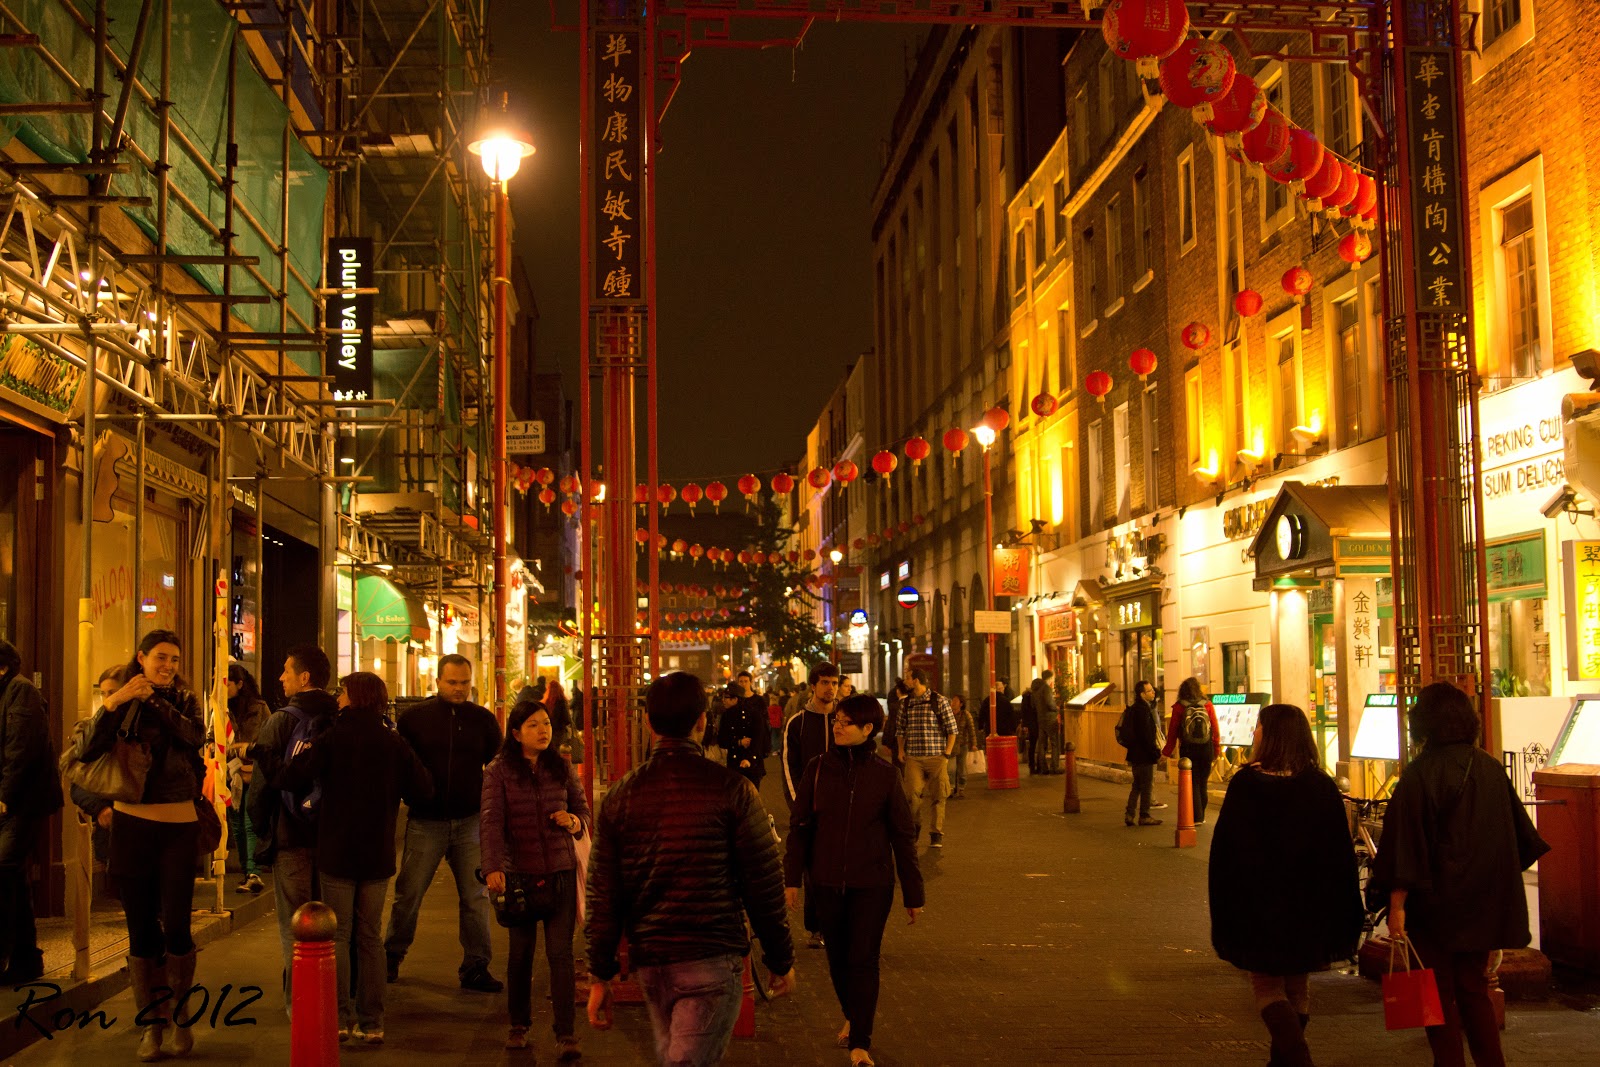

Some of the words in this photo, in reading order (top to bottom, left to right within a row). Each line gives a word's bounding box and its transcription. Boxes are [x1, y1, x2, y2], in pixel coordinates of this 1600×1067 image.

[338, 305, 362, 371] valley
[1487, 424, 1534, 458] PEKING
[1484, 470, 1512, 499] SUM
[1350, 544, 1383, 553] GOLDEN
[385, 614, 406, 624] Salon
[1352, 590, 1374, 668] 金龍軒
